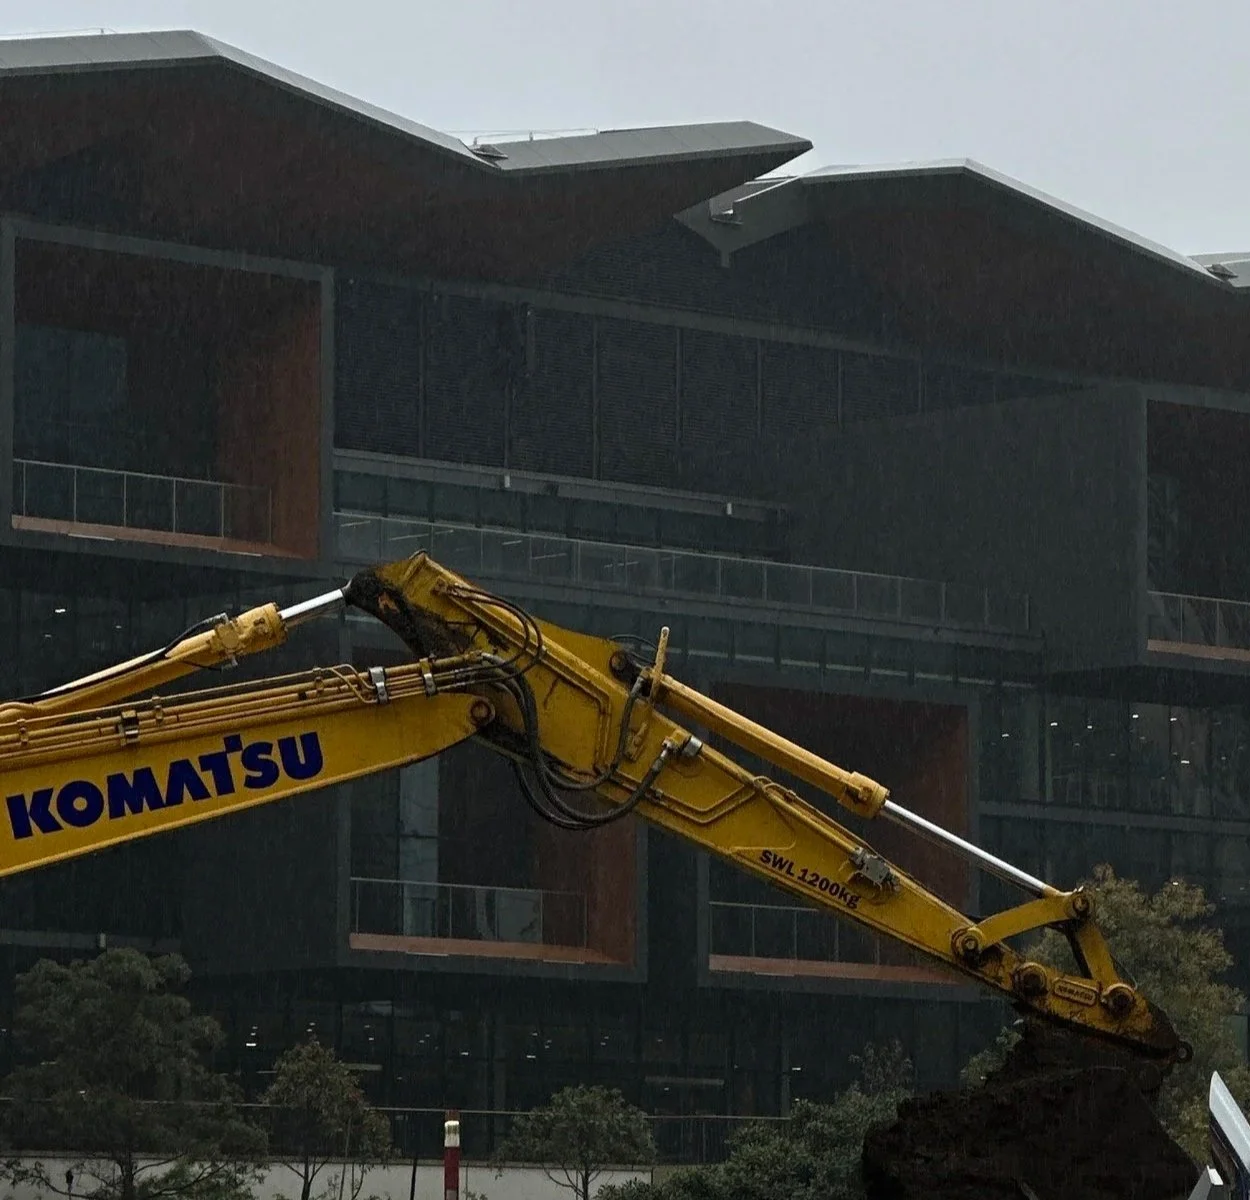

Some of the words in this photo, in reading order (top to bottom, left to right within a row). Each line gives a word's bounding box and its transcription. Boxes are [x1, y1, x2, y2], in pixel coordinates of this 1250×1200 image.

[6, 731, 323, 840] KOMATSU
[760, 849, 795, 876] SWL
[797, 868, 861, 909] 1200kg
